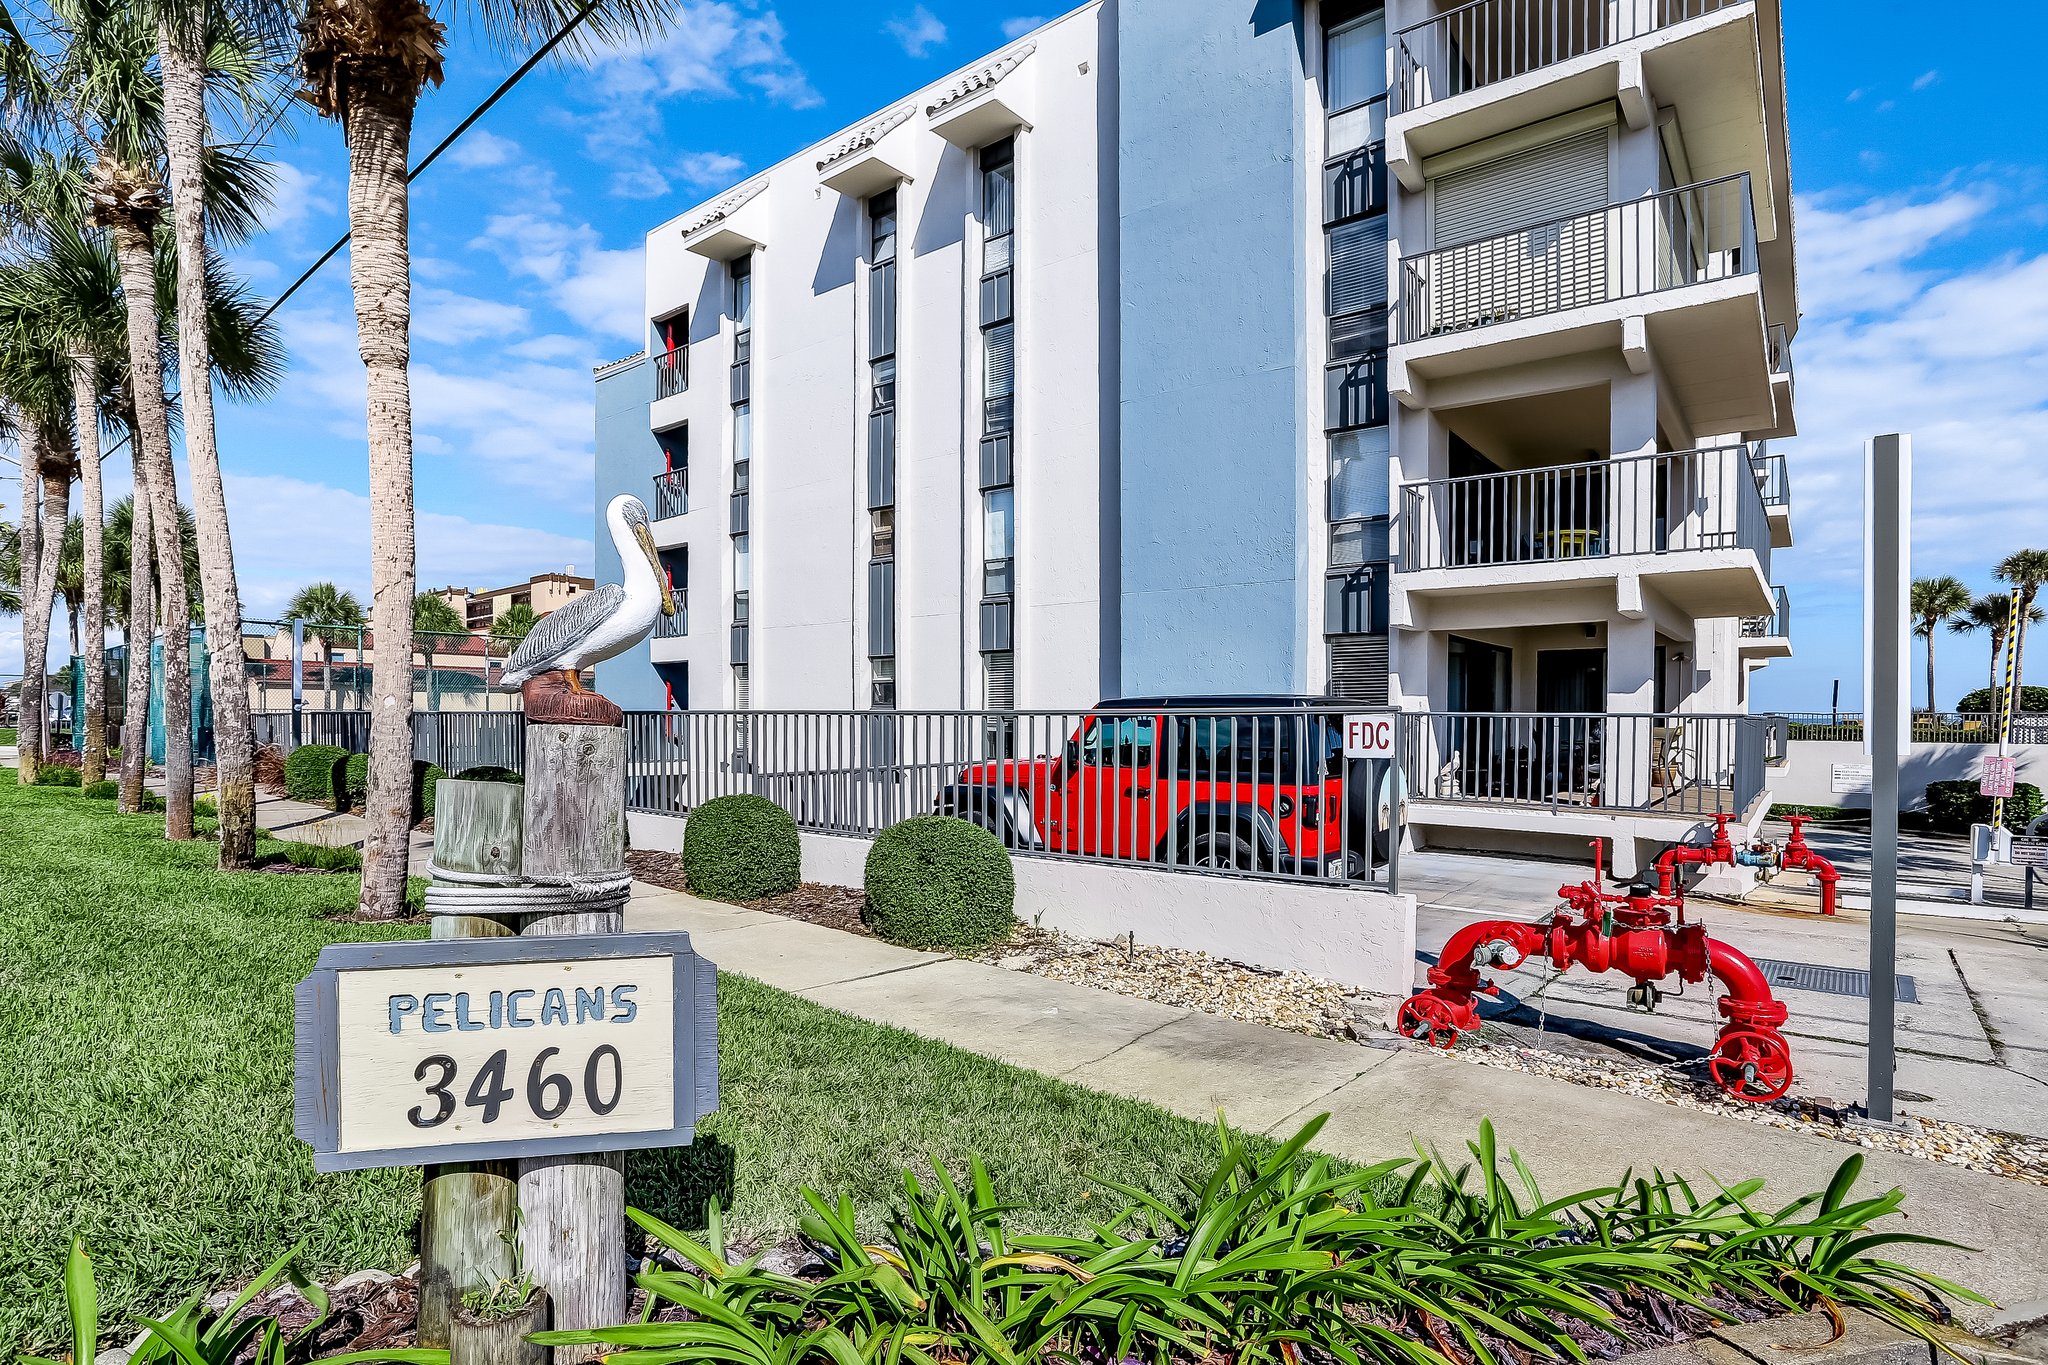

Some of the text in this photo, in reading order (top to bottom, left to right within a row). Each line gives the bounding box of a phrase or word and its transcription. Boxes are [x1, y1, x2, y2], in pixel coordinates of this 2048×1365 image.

[1349, 722, 1390, 750] FDC
[388, 985, 638, 1035] PELICANS
[407, 1044, 622, 1129] 3460
